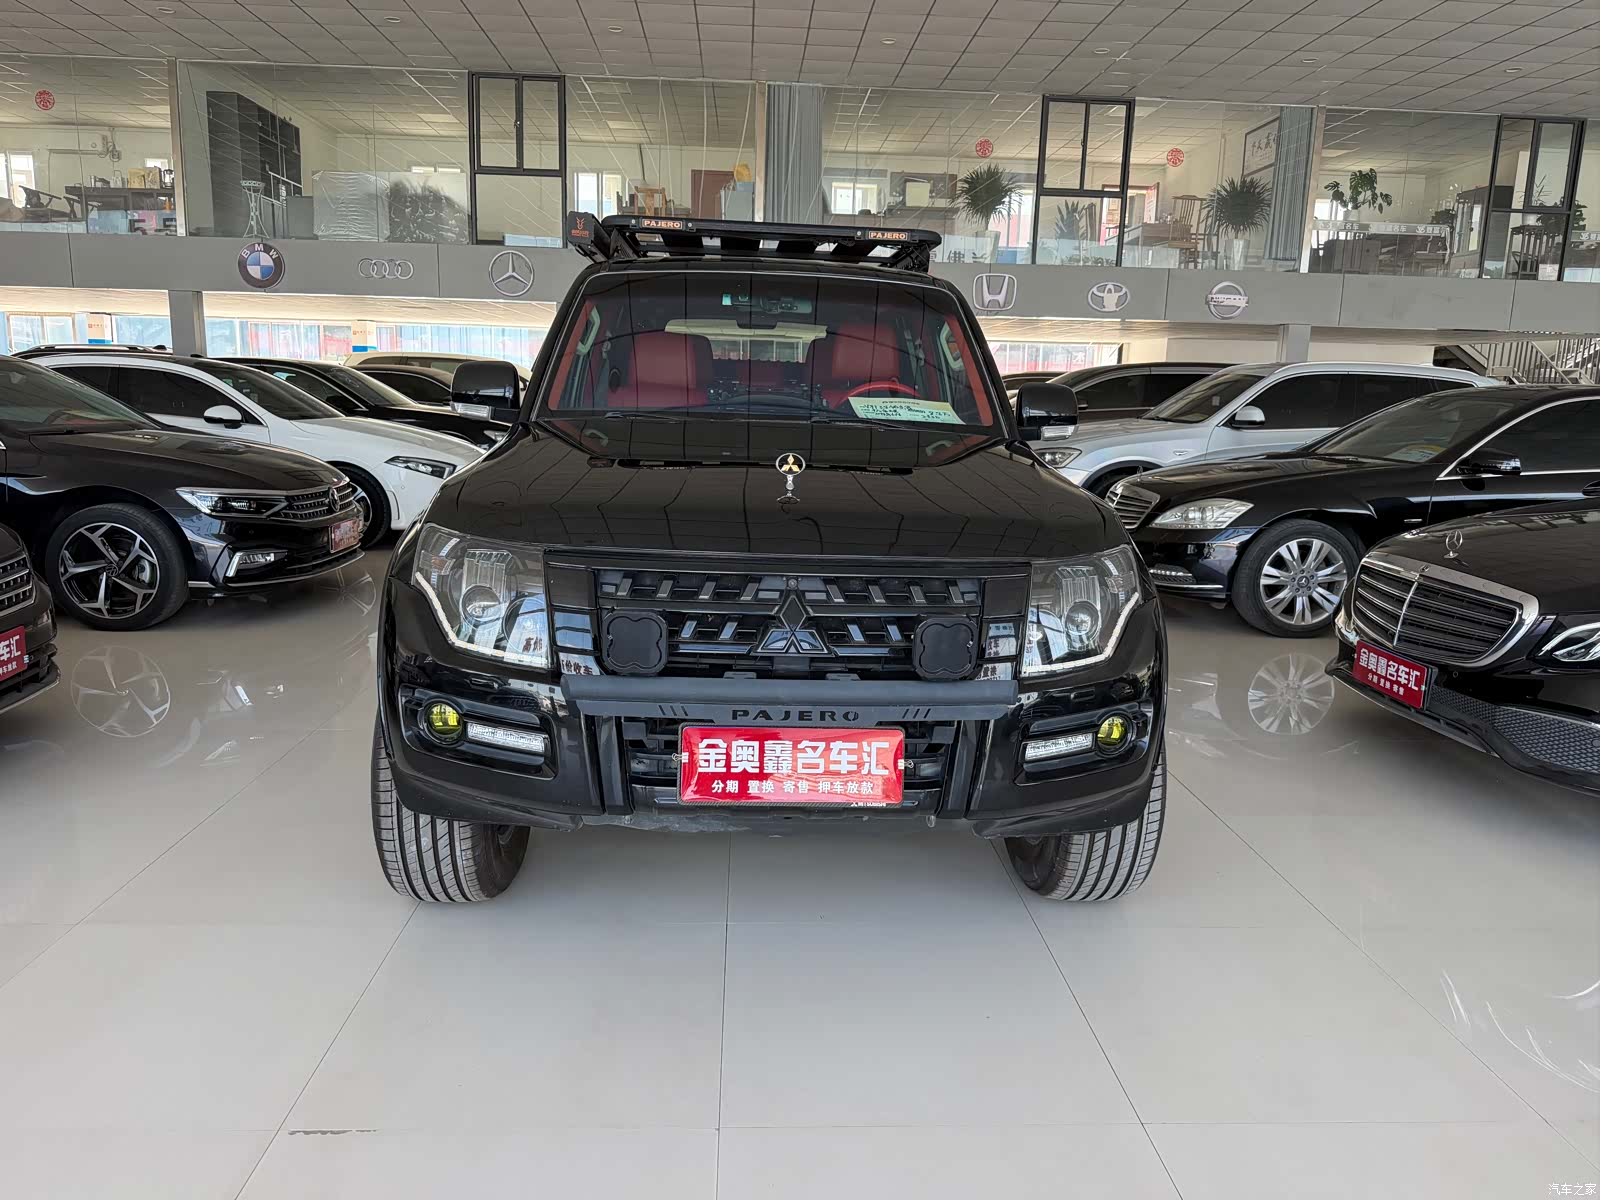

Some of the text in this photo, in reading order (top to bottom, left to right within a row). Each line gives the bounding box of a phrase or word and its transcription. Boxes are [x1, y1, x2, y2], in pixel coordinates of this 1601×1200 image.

[644, 220, 681, 228] PAJERO
[870, 232, 906, 240] PAJERO
[241, 243, 279, 259] BMW
[1359, 648, 1420, 691] 金奥鑫名车汇
[731, 709, 859, 721] PAJERO
[698, 738, 889, 776] 金奥鑫名车汇
[711, 780, 874, 794] 分期 置换 寄售 押车放款
